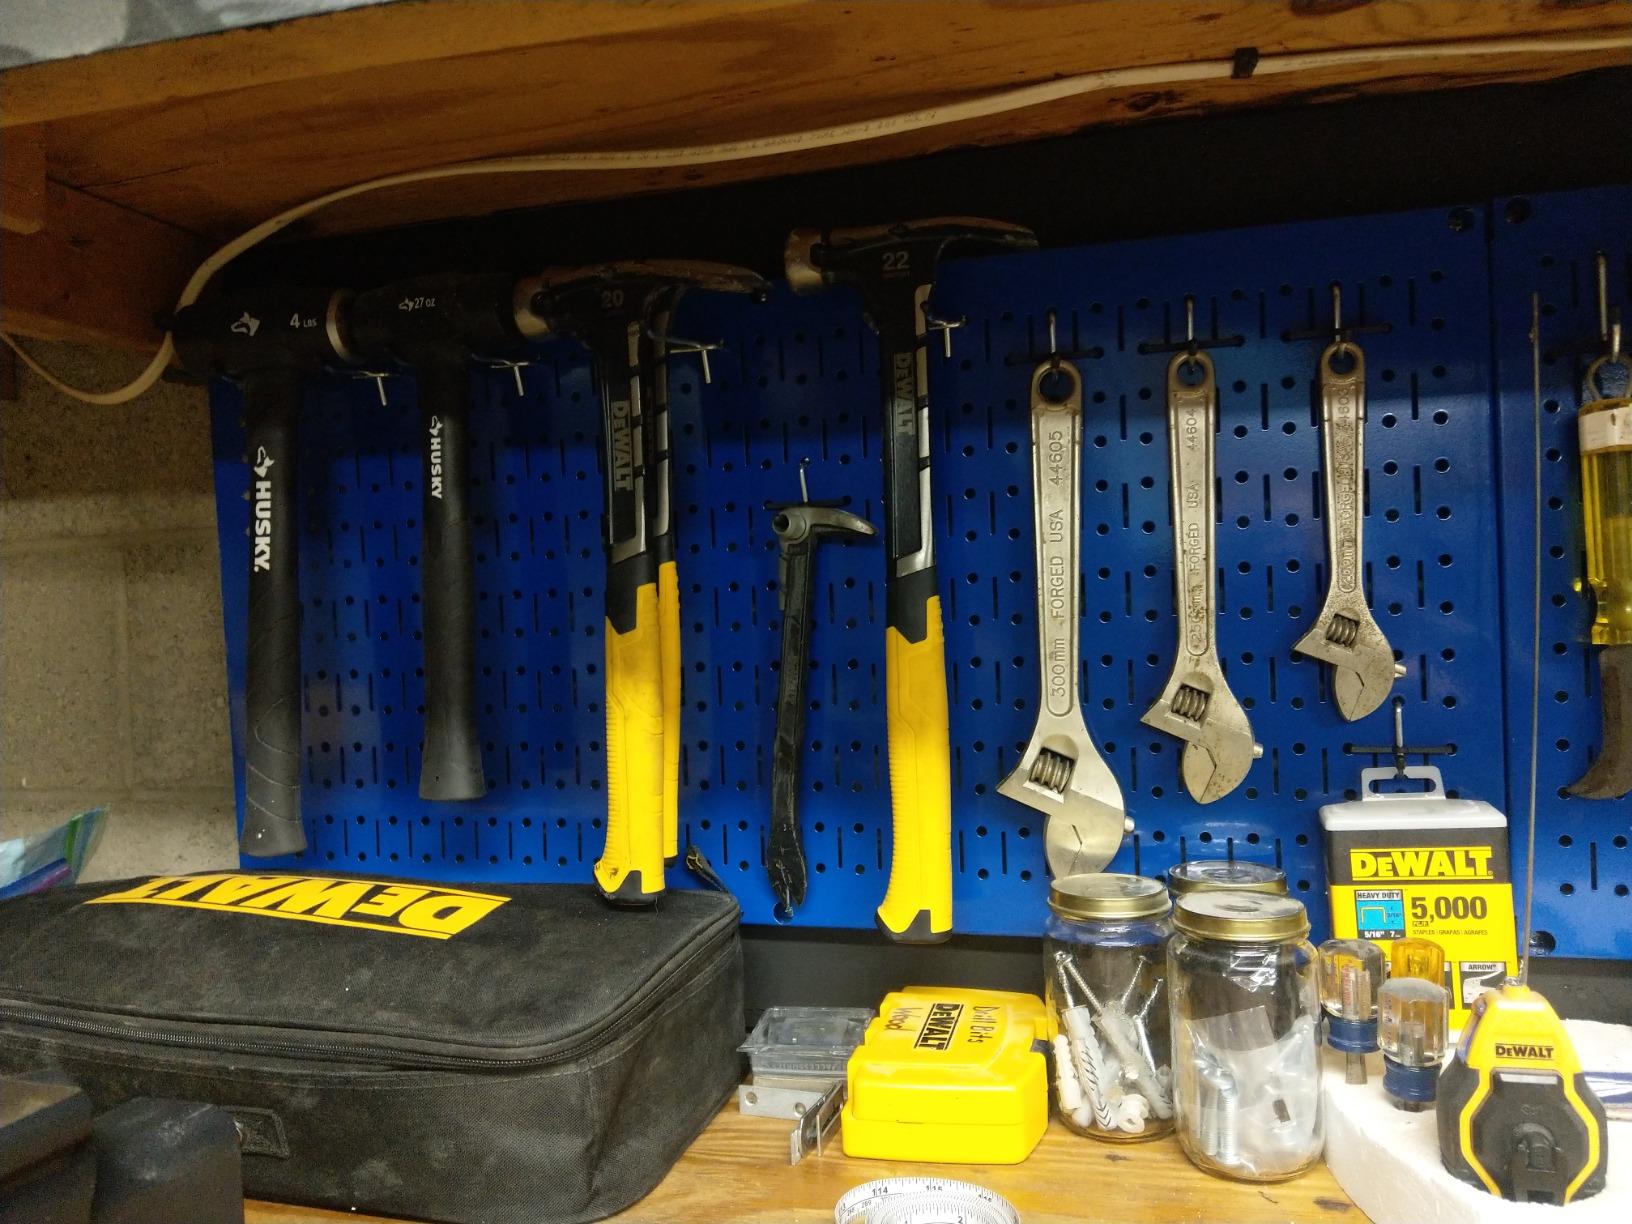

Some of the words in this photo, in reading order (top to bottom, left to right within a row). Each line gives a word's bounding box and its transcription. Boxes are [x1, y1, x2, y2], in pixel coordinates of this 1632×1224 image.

[881, 251, 911, 272] 22
[415, 298, 425, 308] 27
[601, 288, 625, 308] 20
[289, 313, 300, 329] 4
[893, 351, 915, 436] DEWALT
[1185, 408, 1199, 451] 44604
[612, 401, 632, 490] DEWALT
[1047, 430, 1063, 486] 44605
[429, 438, 443, 500] HUSKY
[1186, 482, 1199, 509] USA
[254, 480, 272, 573] HUSKY
[1048, 509, 1063, 543] USA
[1188, 522, 1201, 572] FORGED
[1049, 556, 1066, 619] FORGED
[1351, 849, 1494, 879] DEWALT
[107, 876, 505, 935] DEWALT
[1357, 891, 1380, 899] HEAVY
[1381, 891, 1400, 899] DUTY
[1411, 896, 1487, 922] 5,000
[917, 1003, 962, 1050] DEWALT
[971, 1005, 1000, 1027] Drill
[967, 1026, 994, 1044] Bits
[1495, 1043, 1555, 1060] DEWALT
[872, 1186, 889, 1197] 114
